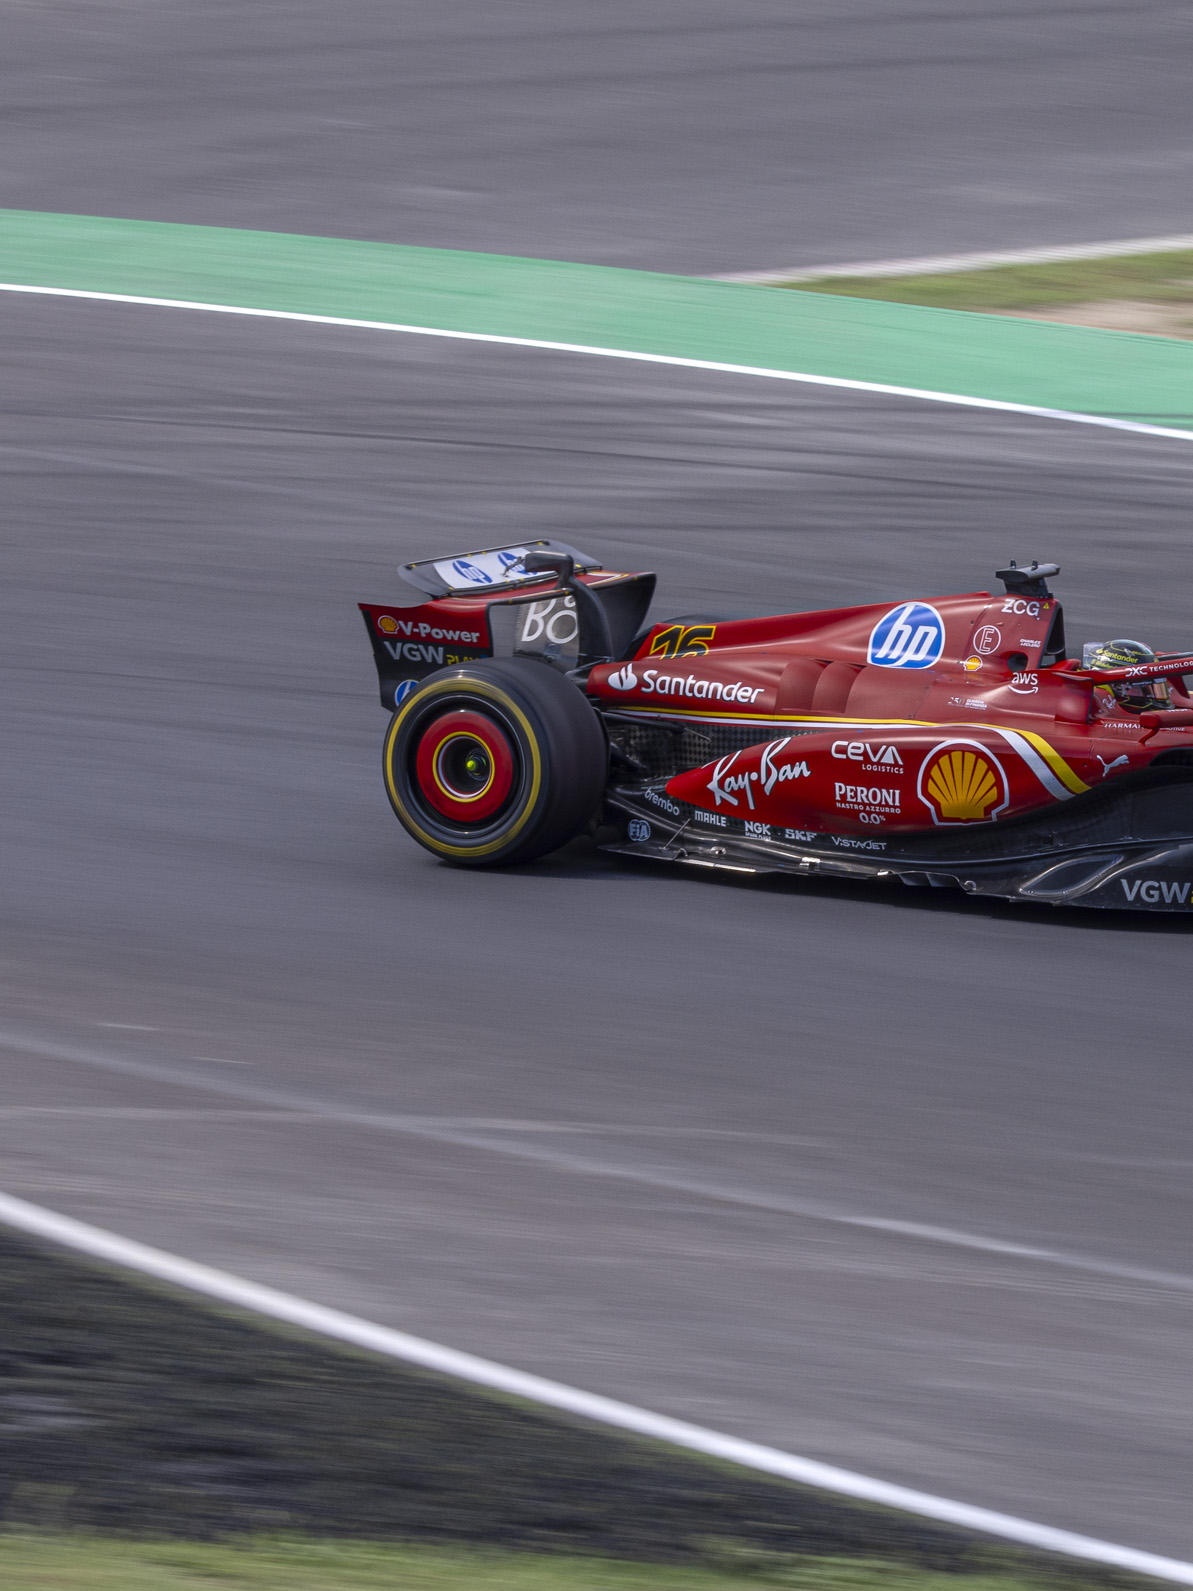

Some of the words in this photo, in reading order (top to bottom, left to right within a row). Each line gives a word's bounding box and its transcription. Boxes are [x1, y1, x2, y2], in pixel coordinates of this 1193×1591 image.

[1001, 598, 1040, 617] ZCG
[398, 620, 480, 643] V-Power
[874, 602, 939, 668] hp
[383, 641, 445, 664] VGW
[641, 669, 765, 704] Santander
[1012, 672, 1038, 686] aws
[861, 763, 904, 774] LOGISTICS
[644, 787, 680, 816] brembo
[834, 782, 900, 806] PERONI
[694, 810, 727, 827] MAHLE
[836, 802, 863, 811] NASTRO
[865, 804, 901, 814] AZZURRO
[744, 820, 771, 836] NGK
[785, 828, 817, 842] SKF
[1120, 878, 1191, 904] VGW
